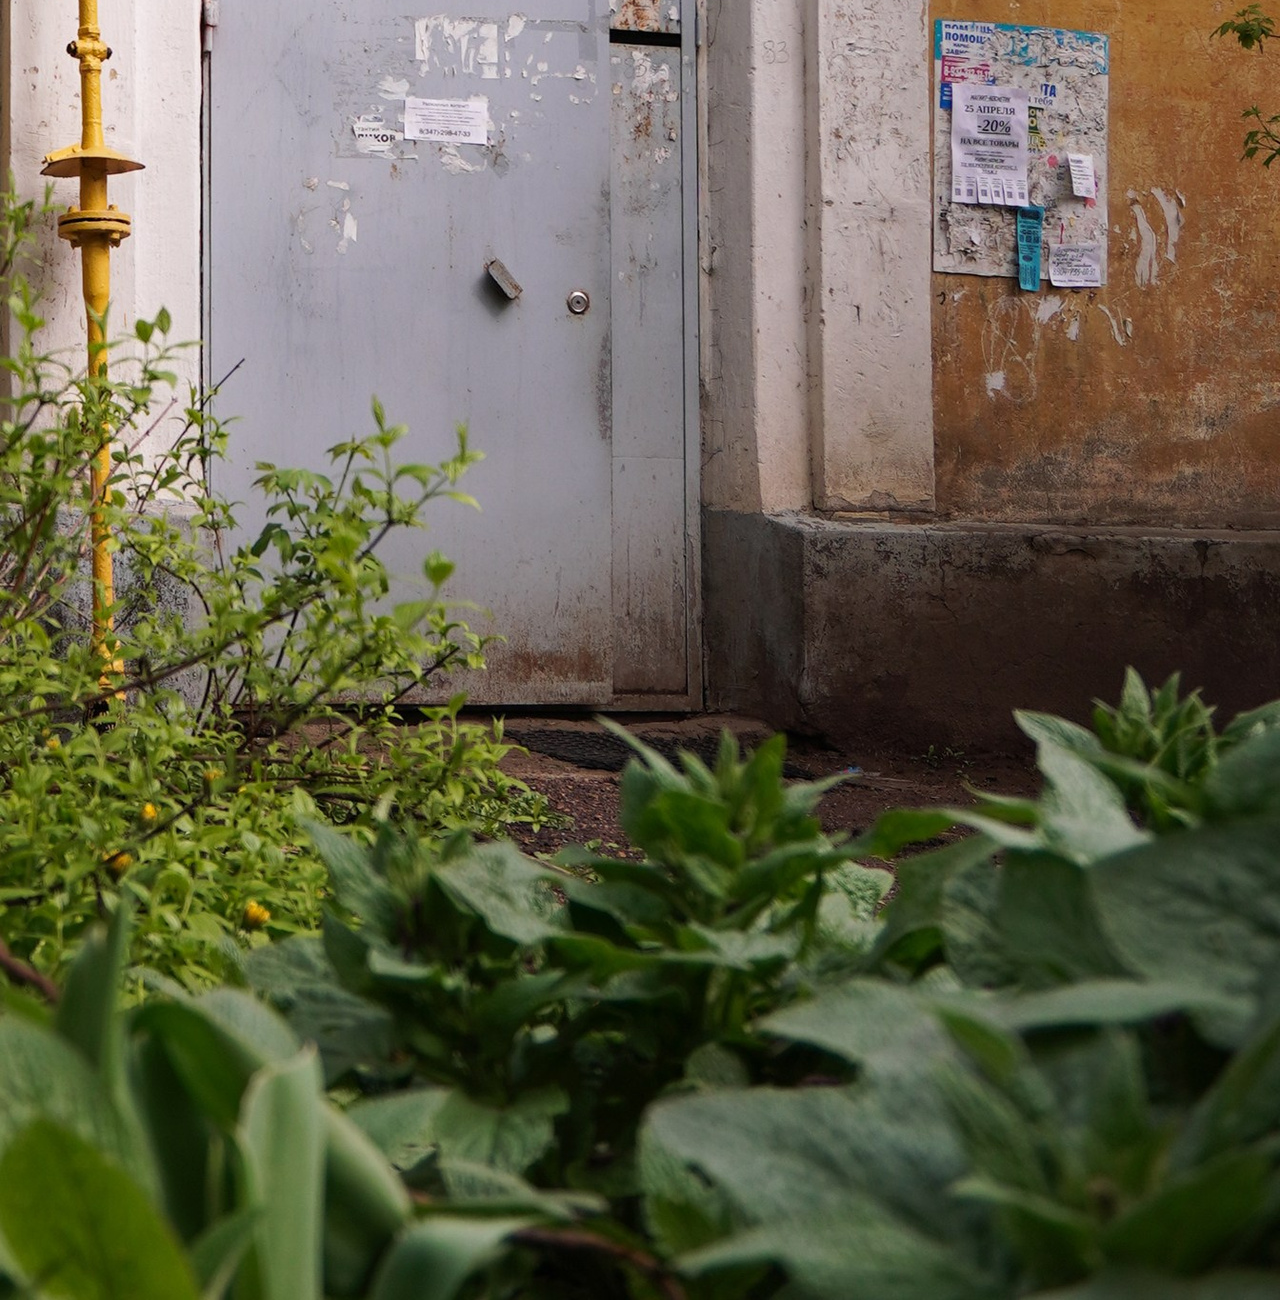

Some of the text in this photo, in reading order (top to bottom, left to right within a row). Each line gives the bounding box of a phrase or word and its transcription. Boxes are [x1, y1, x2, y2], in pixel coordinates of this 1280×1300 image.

[964, 104, 1016, 116] 25 АПРЕЛЯ
[977, 119, 1012, 134] -20%
[989, 140, 1019, 148] ТОВАРЫ
